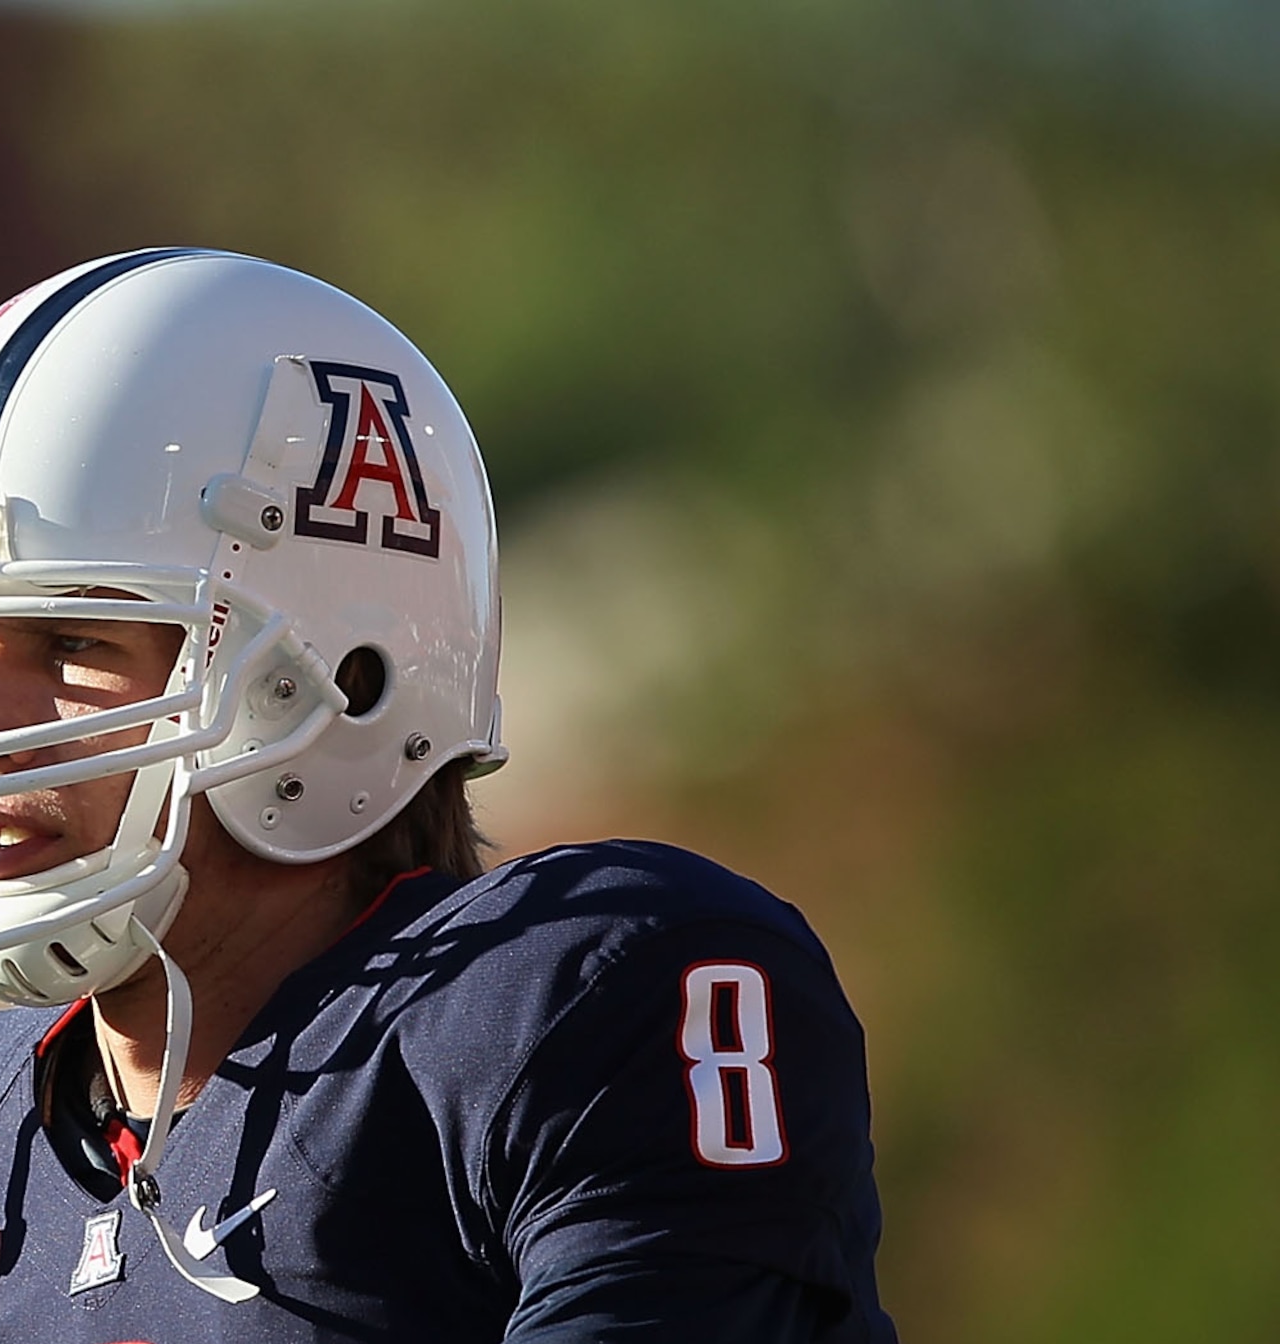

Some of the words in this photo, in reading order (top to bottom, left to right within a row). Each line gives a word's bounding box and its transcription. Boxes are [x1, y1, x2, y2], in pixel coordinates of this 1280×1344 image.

[293, 360, 441, 559] A
[673, 958, 790, 1171] 8
[69, 1210, 124, 1296] A
